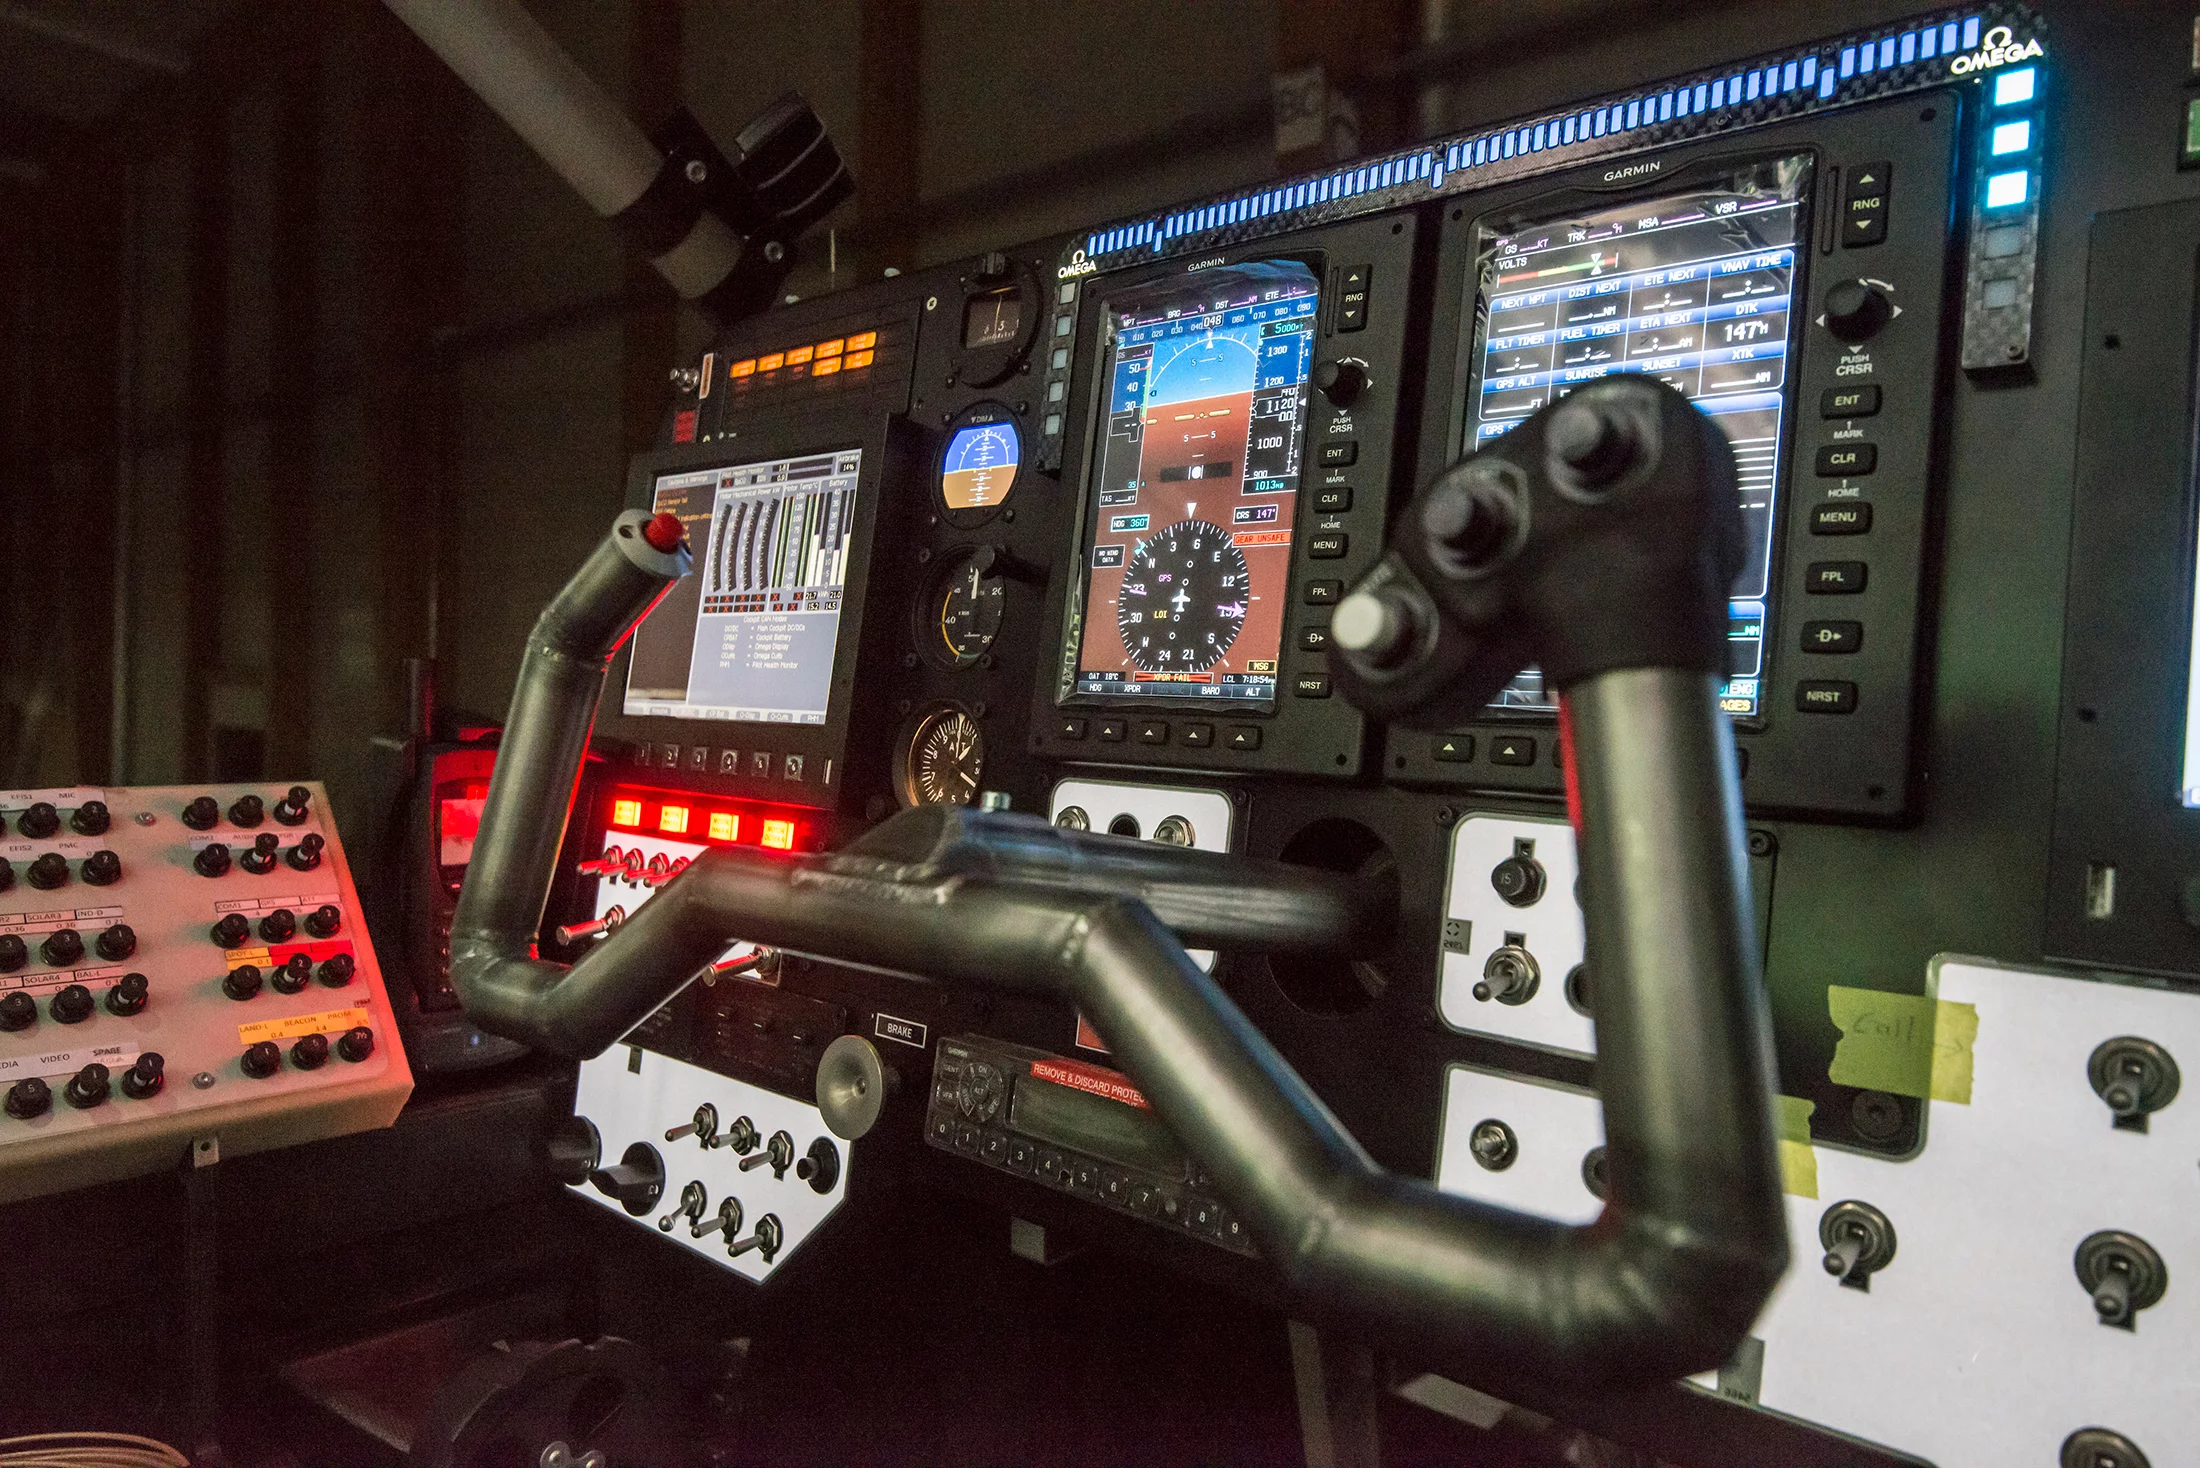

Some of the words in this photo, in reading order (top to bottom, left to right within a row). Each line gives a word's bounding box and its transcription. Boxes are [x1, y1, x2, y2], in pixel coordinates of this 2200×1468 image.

[1951, 38, 2043, 74] OMEGA
[1604, 161, 1660, 182] GARMIN
[1853, 198, 1880, 210] RNG
[1505, 244, 1517, 254] GS
[1568, 230, 1586, 242] TRK
[1638, 217, 1659, 229] MSA
[1716, 201, 1737, 214] VSR
[1188, 257, 1225, 272] GARMIN
[1499, 257, 1527, 270] VOLTS
[1721, 259, 1750, 273] VNAV
[1756, 254, 1782, 267] TIME
[1058, 260, 1096, 278] OMEGA
[1644, 272, 1664, 285] ETE
[1669, 268, 1696, 282] NEXT
[1568, 286, 1591, 299] DIST
[1596, 281, 1621, 294] NEXT
[1216, 301, 1228, 310] DST
[1265, 291, 1279, 300] ETE
[1346, 293, 1363, 302] RNG
[1502, 297, 1525, 309] NEXT
[1603, 306, 1616, 315] NM
[1736, 303, 1758, 315] DTK
[1168, 310, 1180, 319] BRG
[1152, 330, 1163, 338] 020
[1204, 315, 1221, 327] 048
[1253, 311, 1266, 320] 070
[1640, 318, 1660, 329] ETA
[1665, 312, 1692, 325] NEXT
[1561, 329, 1586, 340] FUEL
[1591, 322, 1620, 336] TIMER
[1496, 339, 1513, 350] FLT
[1518, 334, 1545, 346] TIMER
[1267, 346, 1288, 357] 1300
[1732, 348, 1754, 360] XTK
[1642, 357, 1682, 371] SUNSET
[1841, 354, 1869, 364] PUSH
[1129, 363, 1140, 374] 50
[1566, 367, 1608, 380] SUNRISE
[1836, 363, 1873, 376] CRSR
[1264, 376, 1284, 388] 1200
[1756, 372, 1771, 382] NM
[1127, 382, 1138, 392] 40
[1496, 380, 1514, 389] GPS
[1518, 376, 1536, 386] ALT
[1835, 394, 1860, 406] ENT
[1267, 398, 1294, 413] 1120
[1329, 424, 1352, 434] CRSR
[1486, 425, 1503, 435] GPS
[1834, 430, 1863, 439] MARK
[1257, 437, 1282, 449] 1000
[1327, 449, 1343, 457] ENT
[1830, 453, 1855, 464] CLR
[829, 479, 848, 487] Battery
[1828, 488, 1859, 497] HOME
[1236, 511, 1250, 519] CRS
[1820, 511, 1856, 522] MENU
[1258, 534, 1285, 542] UNSAFE
[1170, 542, 1177, 552] 3
[1194, 539, 1200, 549] 6
[1314, 541, 1337, 549] MENU
[1214, 551, 1221, 562] E
[1149, 558, 1156, 568] N
[1159, 574, 1172, 582] GPS
[1222, 576, 1235, 587] 12
[1822, 571, 1844, 582] FPL
[825, 602, 836, 610] 14.5
[1130, 613, 1142, 623] 30
[1154, 610, 1167, 619] LOI
[945, 616, 956, 624] 40
[1159, 651, 1171, 661] 24
[1183, 649, 1194, 660] 21
[1174, 674, 1191, 682] FAIL
[1202, 687, 1220, 695] BARO
[1246, 688, 1260, 696] ALT
[1807, 691, 1840, 702] NRST
[943, 736, 948, 745] 9
[25, 975, 60, 984] SOLAR4
[284, 1017, 317, 1027] BEACON
[328, 1011, 352, 1019] PROM
[887, 1023, 912, 1039] BRAKE
[40, 1054, 70, 1064] VIDEO
[93, 1047, 121, 1056] SPARE
[1034, 1064, 1066, 1081] REMOVE
[1068, 1073, 1072, 1082] &
[1075, 1075, 1110, 1093] DISCARD
[939, 1125, 945, 1133] 0
[965, 1133, 970, 1141] 1
[991, 1142, 996, 1150] 2
[1018, 1151, 1023, 1160] 3
[1045, 1161, 1051, 1169] 4
[1081, 1173, 1087, 1182] 5
[1111, 1182, 1116, 1192] 6
[1143, 1193, 1148, 1202] 7
[1200, 1212, 1206, 1222] 8
[1232, 1223, 1238, 1233] 9
